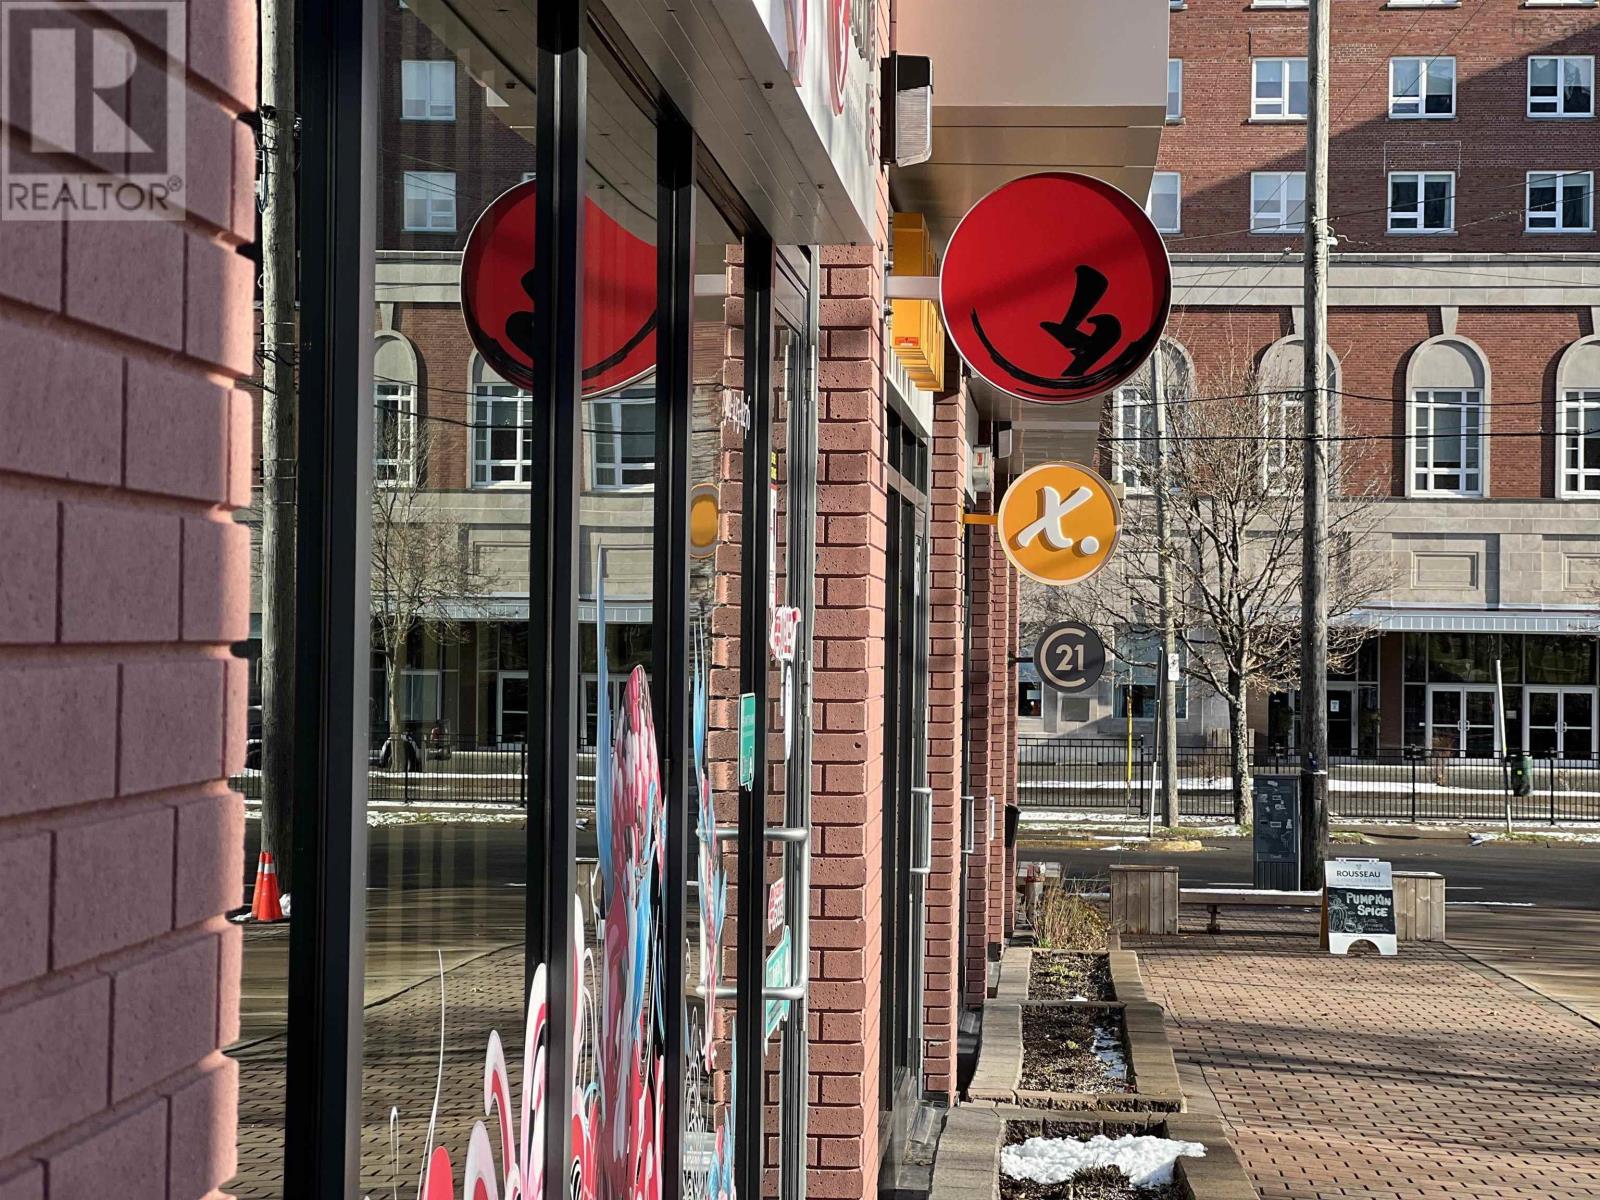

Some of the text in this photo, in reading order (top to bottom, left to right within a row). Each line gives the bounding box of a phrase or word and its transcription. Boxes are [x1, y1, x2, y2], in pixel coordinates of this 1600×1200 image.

[1055, 644, 1084, 671] 21
[1336, 870, 1381, 878] ROUSSEAU
[1357, 905, 1389, 917] SPICE
